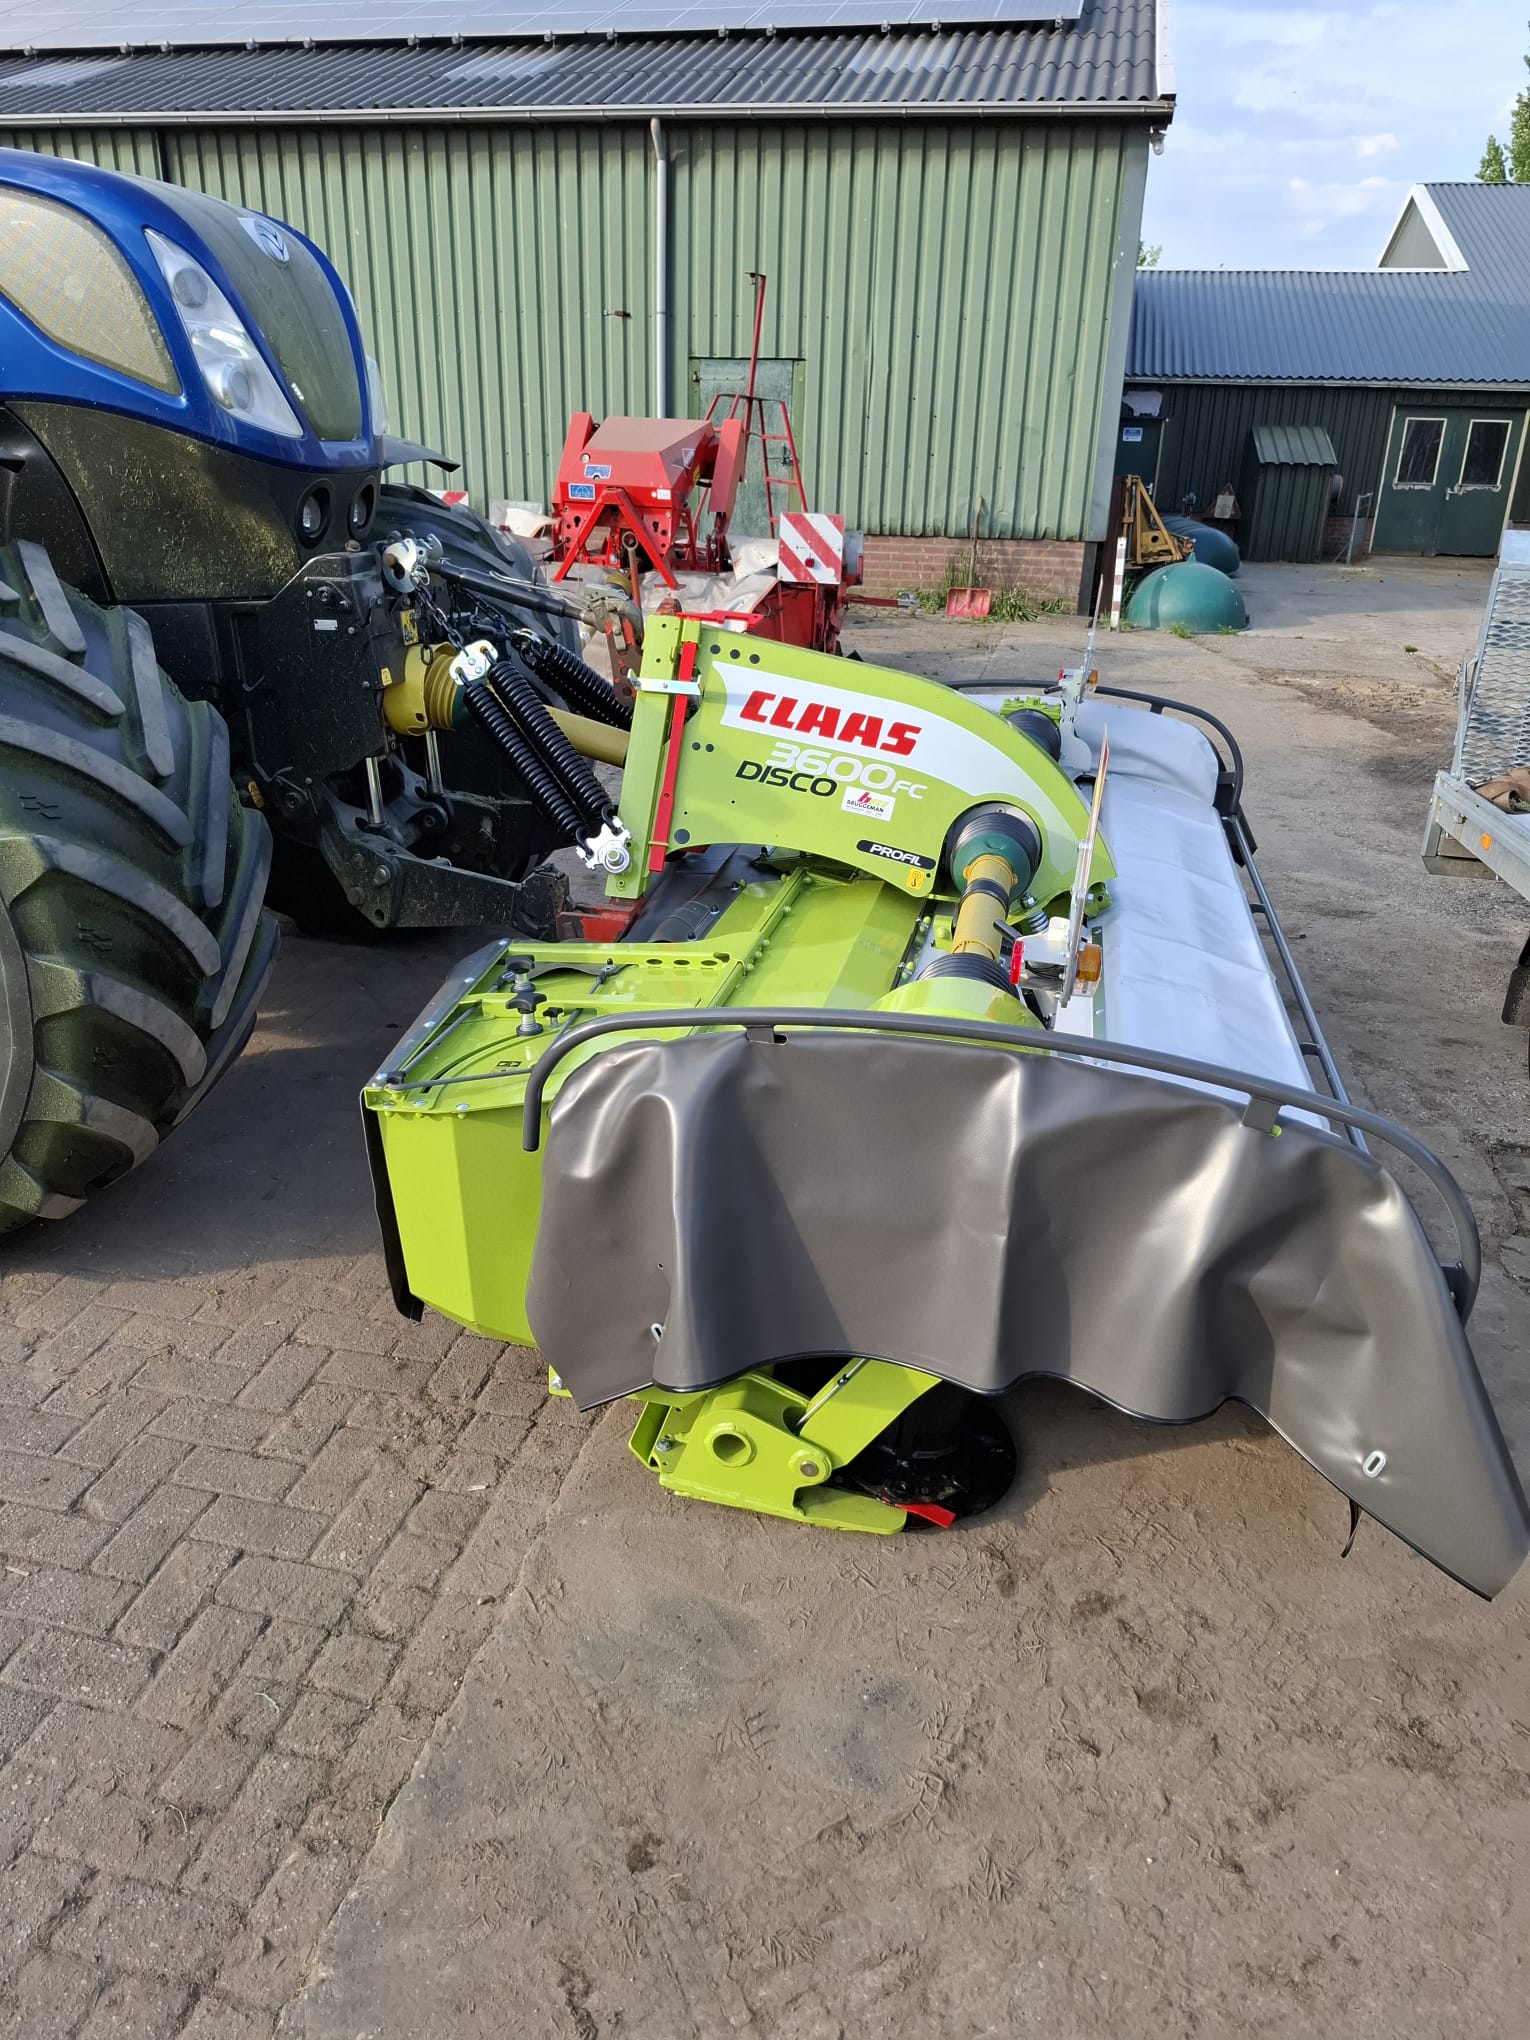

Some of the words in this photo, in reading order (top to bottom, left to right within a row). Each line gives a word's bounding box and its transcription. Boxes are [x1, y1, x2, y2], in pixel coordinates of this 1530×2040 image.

[740, 690, 922, 756] CLAAS
[735, 760, 838, 797] DISCO
[847, 800, 884, 813] BRUGGEMAN
[869, 844, 922, 867] PROFIL
